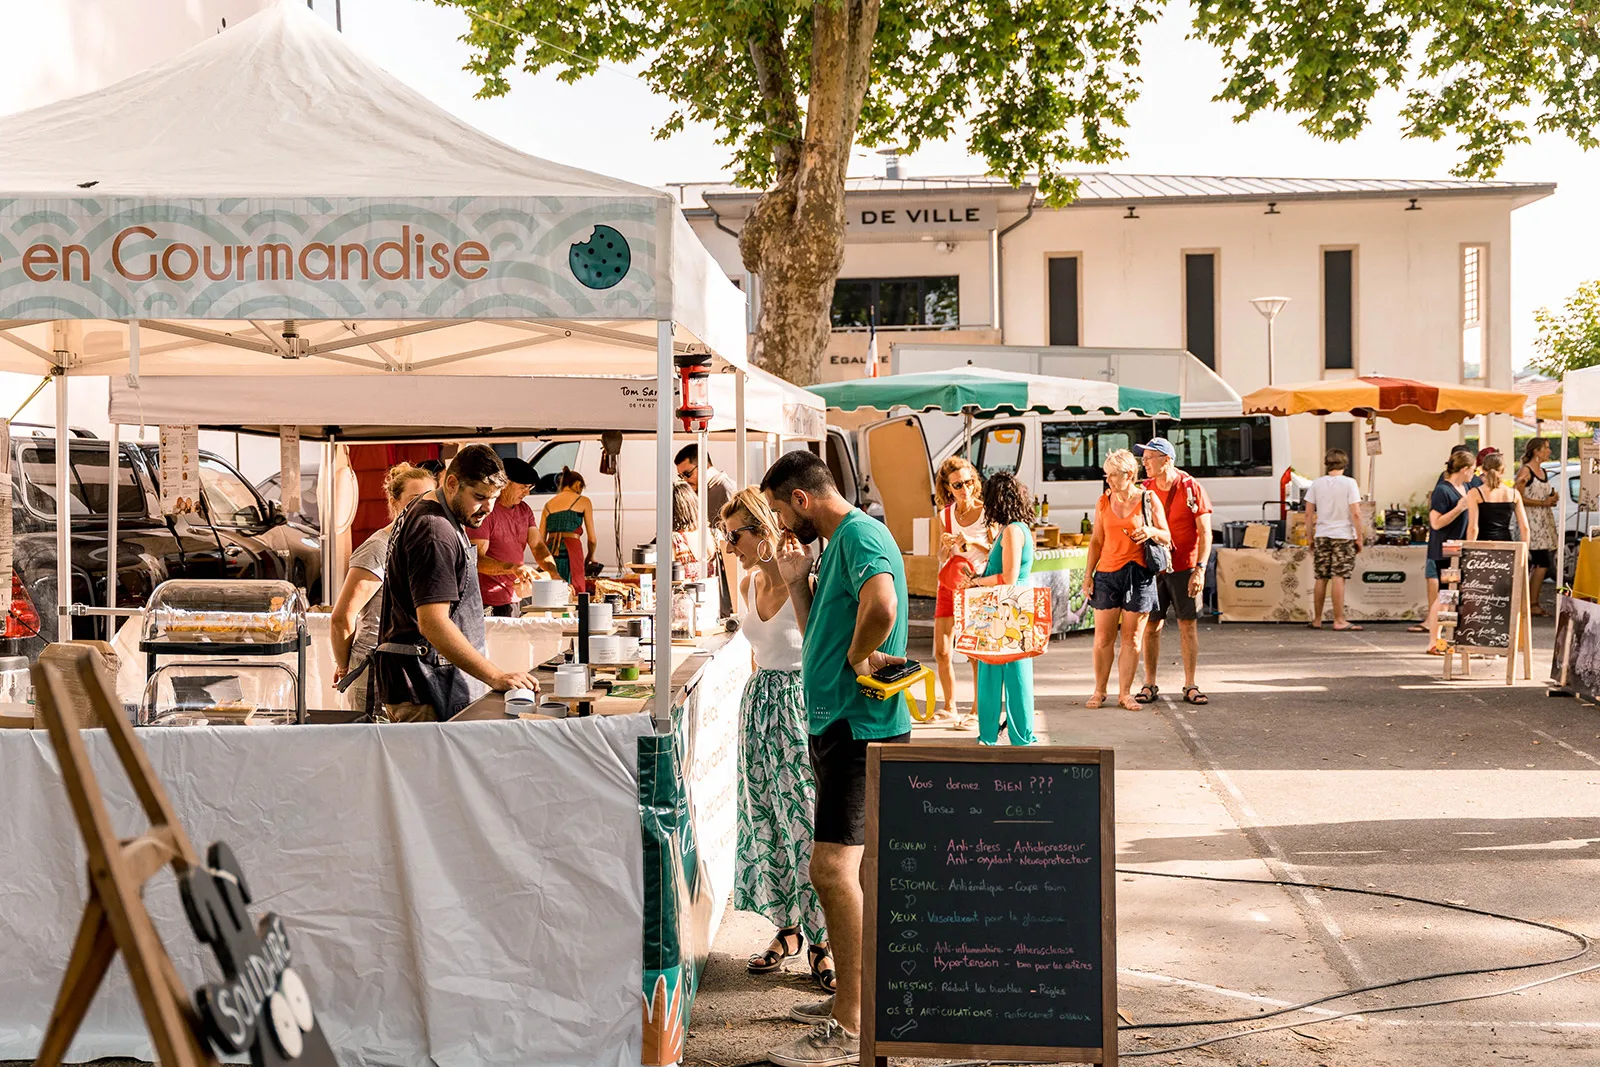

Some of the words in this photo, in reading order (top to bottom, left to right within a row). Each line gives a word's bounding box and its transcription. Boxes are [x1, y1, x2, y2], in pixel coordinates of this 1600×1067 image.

[861, 210, 896, 224] DE
[906, 208, 980, 224] VILLE
[22, 242, 91, 283] en
[111, 224, 492, 283] Gourmandise
[830, 355, 889, 365] EGALE
[620, 386, 639, 396] Tom
[908, 776, 932, 789] Vous
[946, 777, 979, 790] dormez
[1030, 776, 1053, 794] ???
[923, 801, 954, 813] Pensez
[889, 839, 926, 850] CERVEAU
[1020, 854, 1091, 868] Neuroprotecteur
[934, 955, 998, 971] Hypertension
